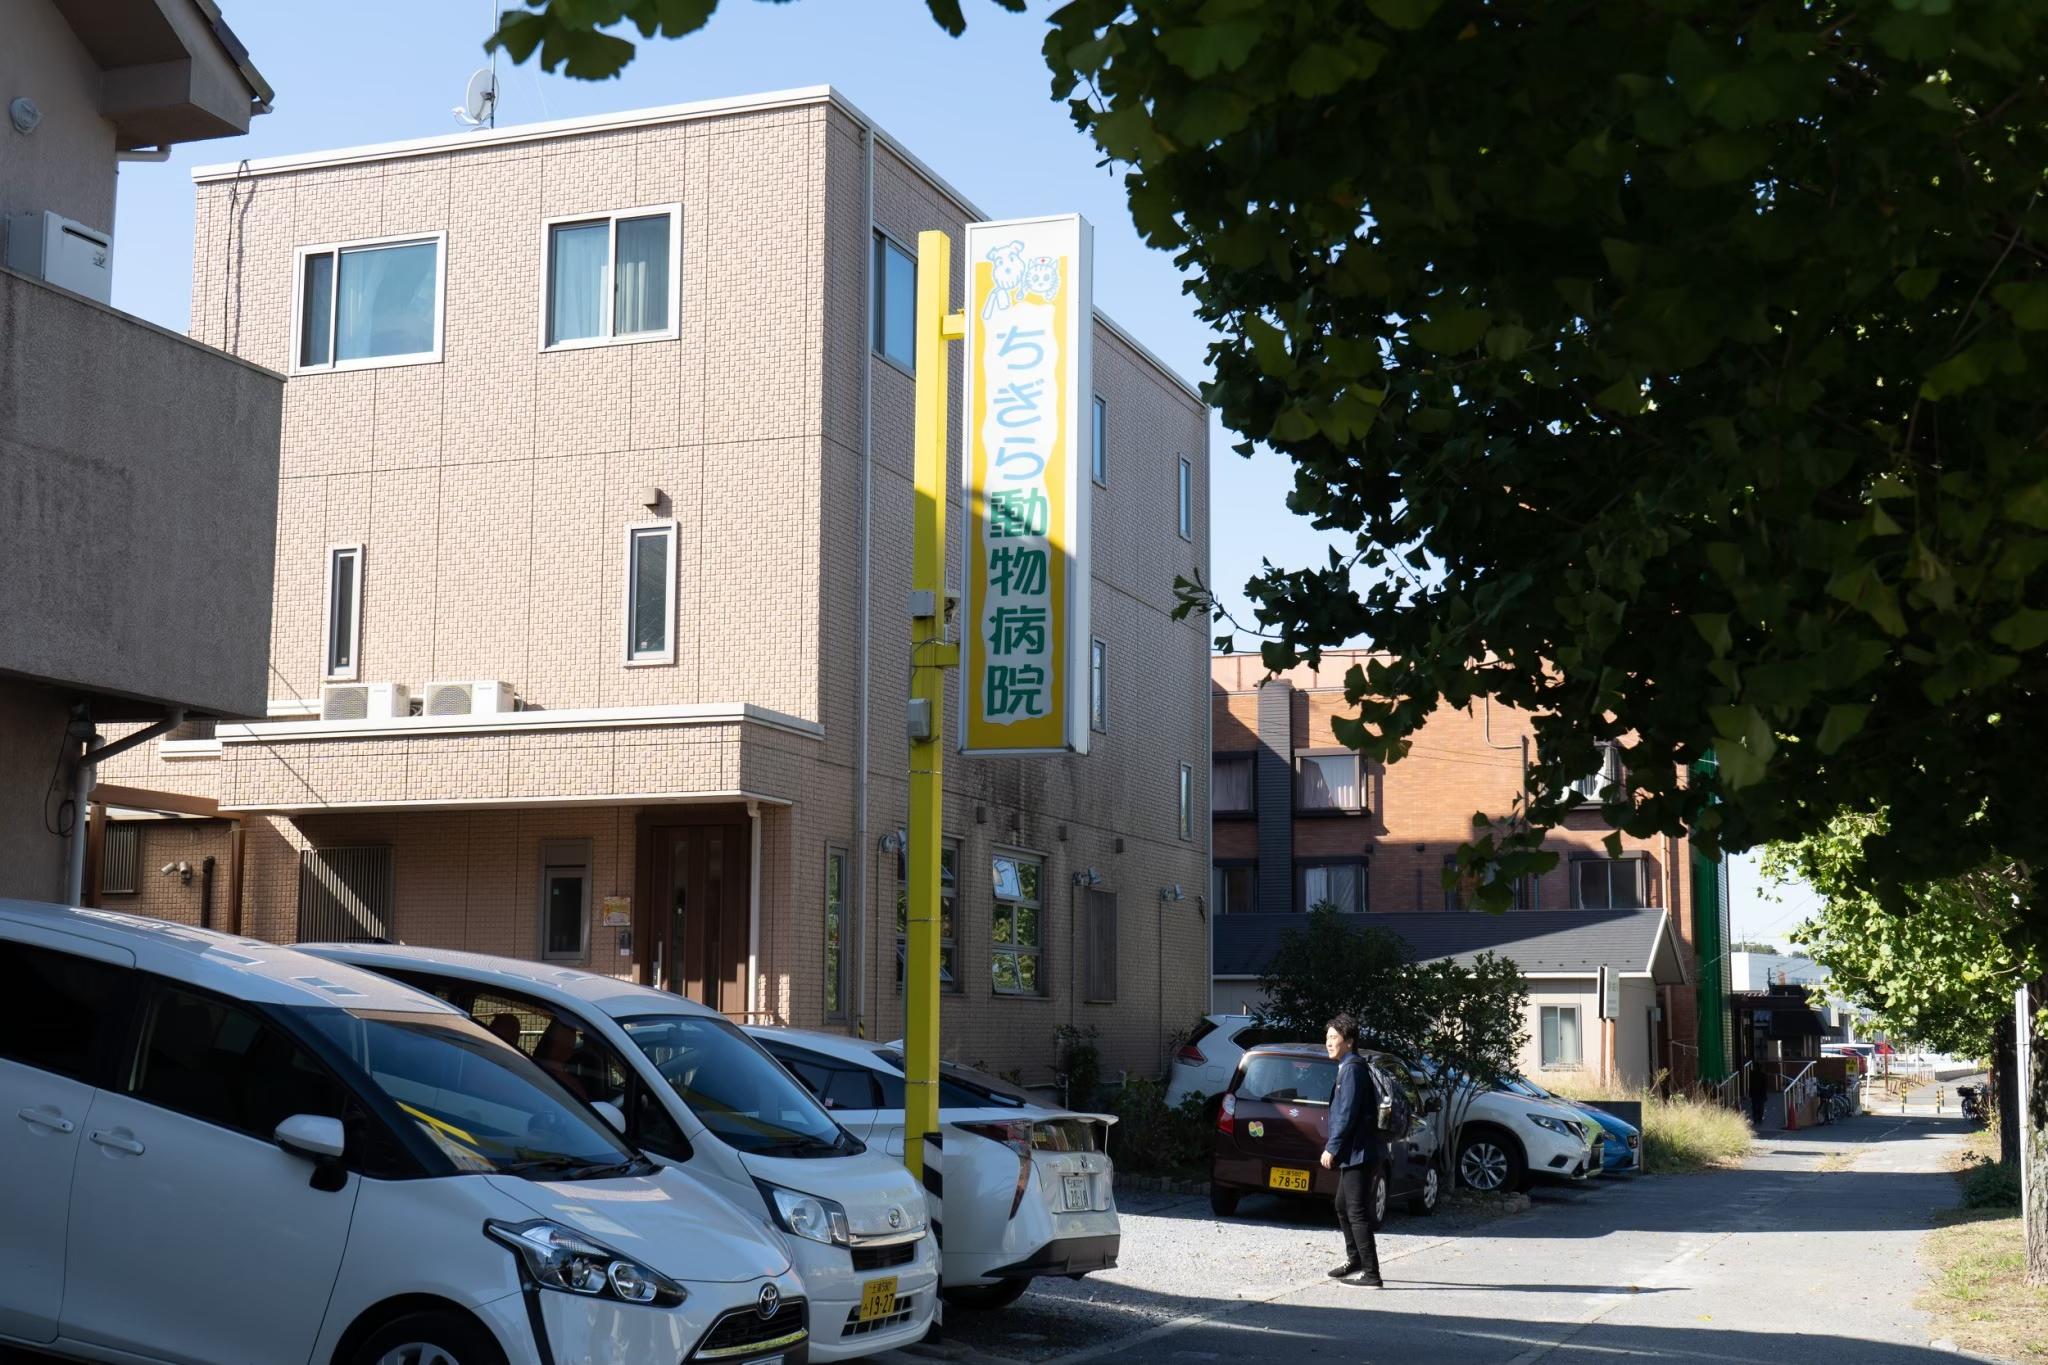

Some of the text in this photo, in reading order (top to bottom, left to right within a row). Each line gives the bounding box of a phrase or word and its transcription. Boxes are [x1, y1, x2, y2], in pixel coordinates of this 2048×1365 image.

[987, 325, 1049, 716] ちぎら動物病院
